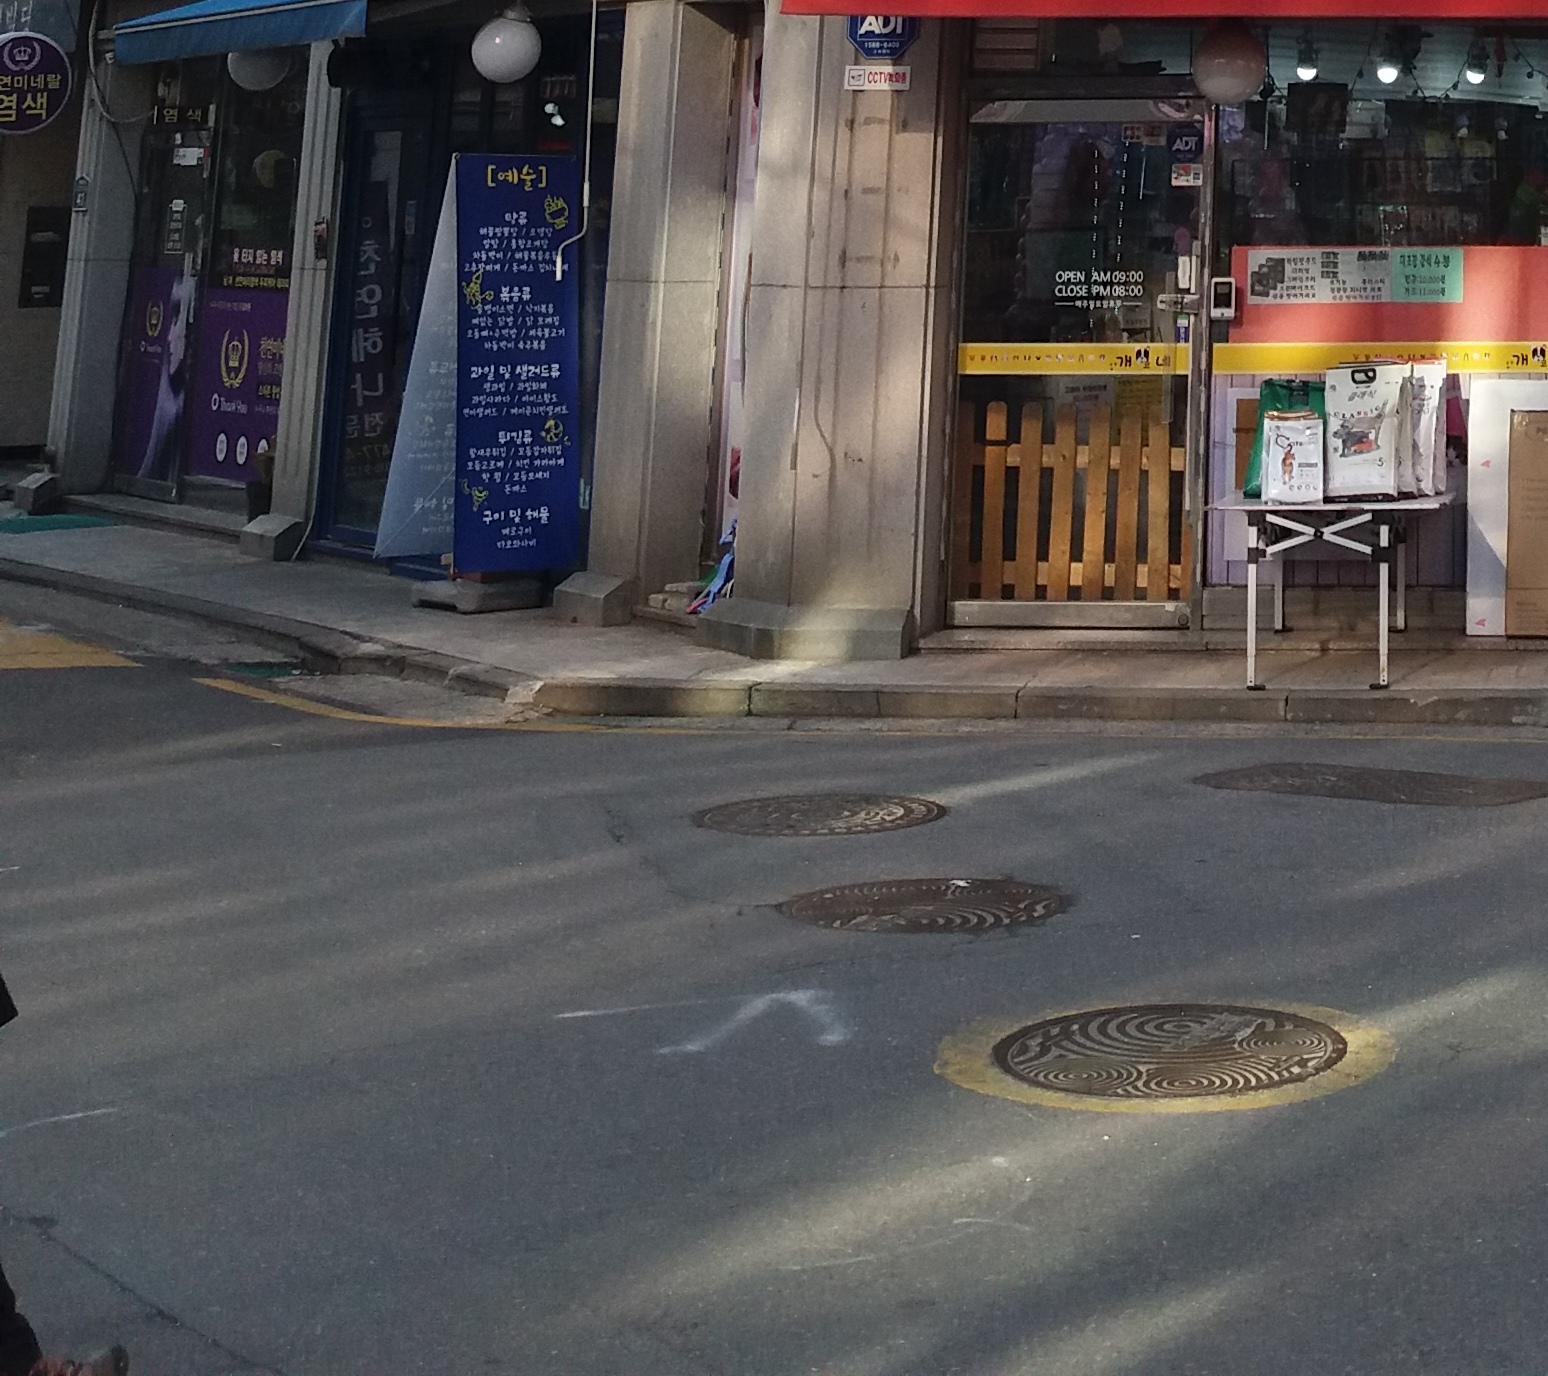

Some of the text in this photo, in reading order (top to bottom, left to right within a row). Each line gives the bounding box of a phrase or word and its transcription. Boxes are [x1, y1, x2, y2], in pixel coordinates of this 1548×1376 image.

[1172, 136, 1199, 152] ADT
[1055, 270, 1144, 283] OPEN AM 09:00
[500, 285, 532, 303] 볶음류
[1054, 284, 1144, 297] CLOSE PM 08:00
[470, 364, 496, 381] 과일
[515, 363, 561, 380] 샐러드류
[498, 429, 533, 445] 튀김류
[482, 509, 506, 525] 구이
[525, 505, 551, 524] 해물
